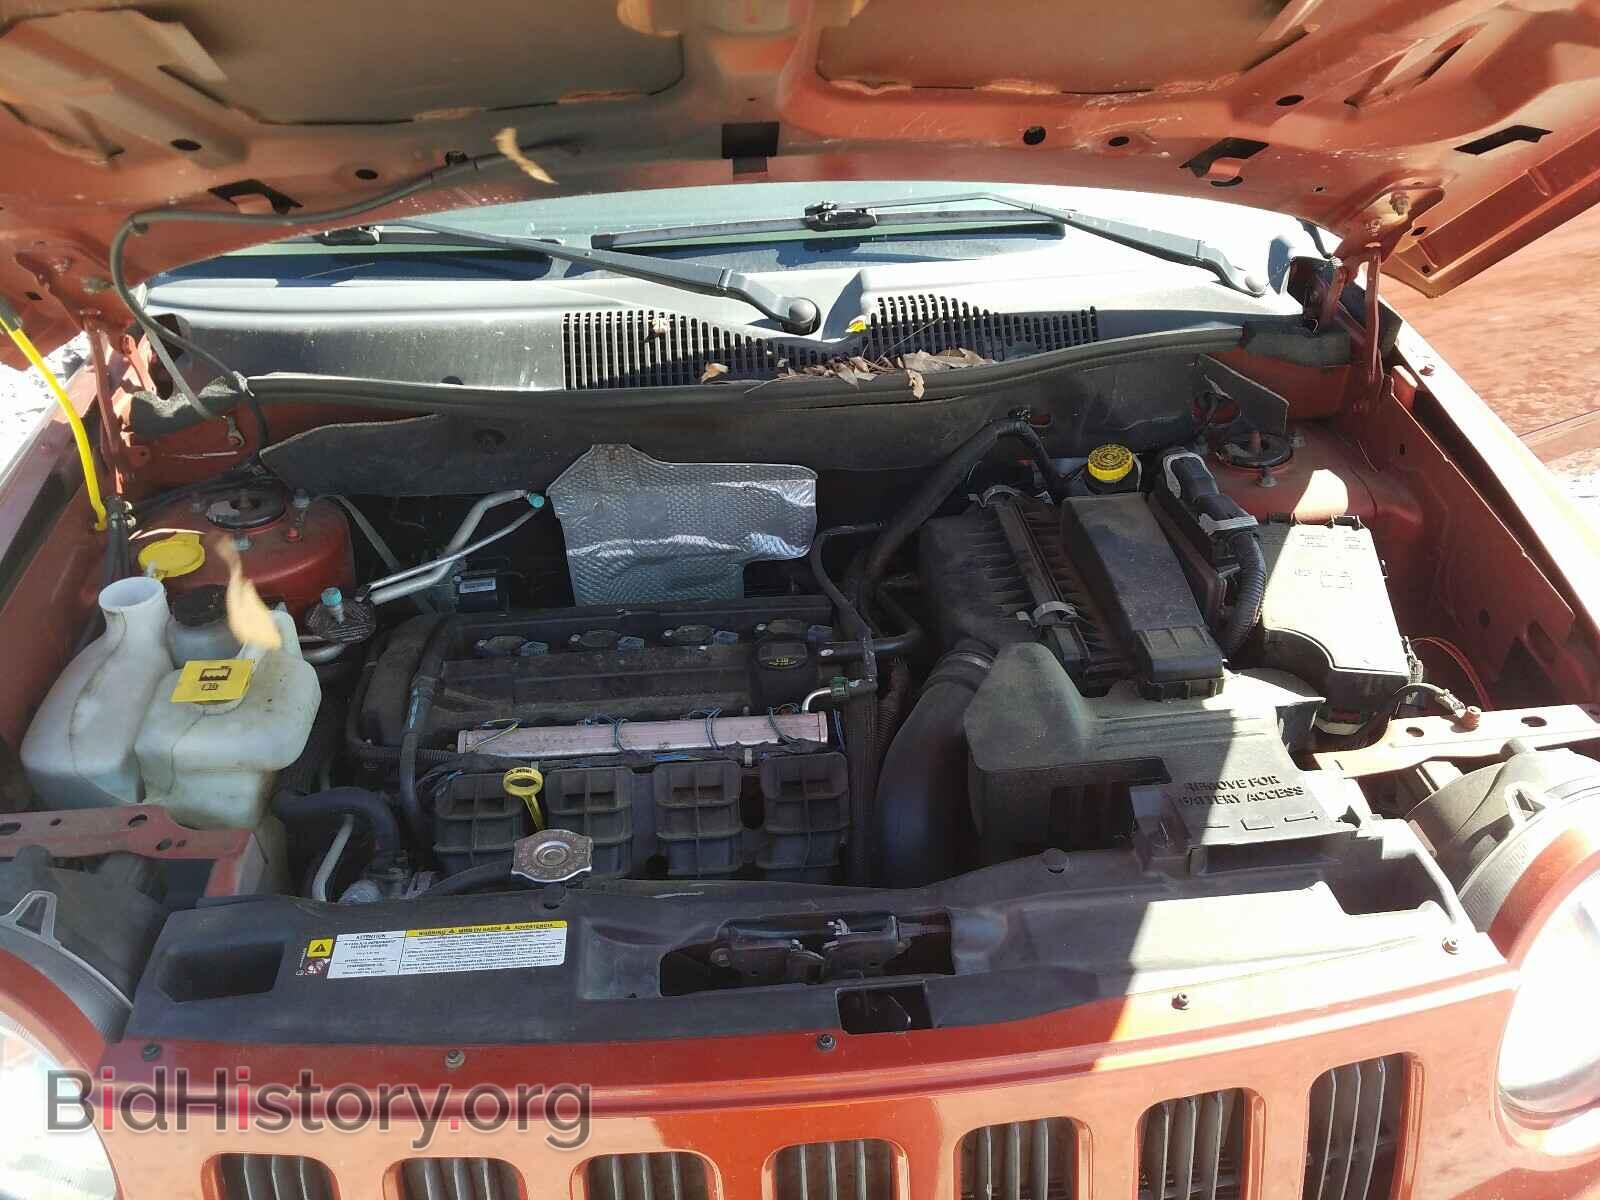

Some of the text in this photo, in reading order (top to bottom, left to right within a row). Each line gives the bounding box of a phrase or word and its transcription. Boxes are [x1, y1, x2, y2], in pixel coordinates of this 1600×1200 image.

[1185, 775, 1280, 791] REMOVE FOR
[1247, 787, 1304, 802] ACCESS
